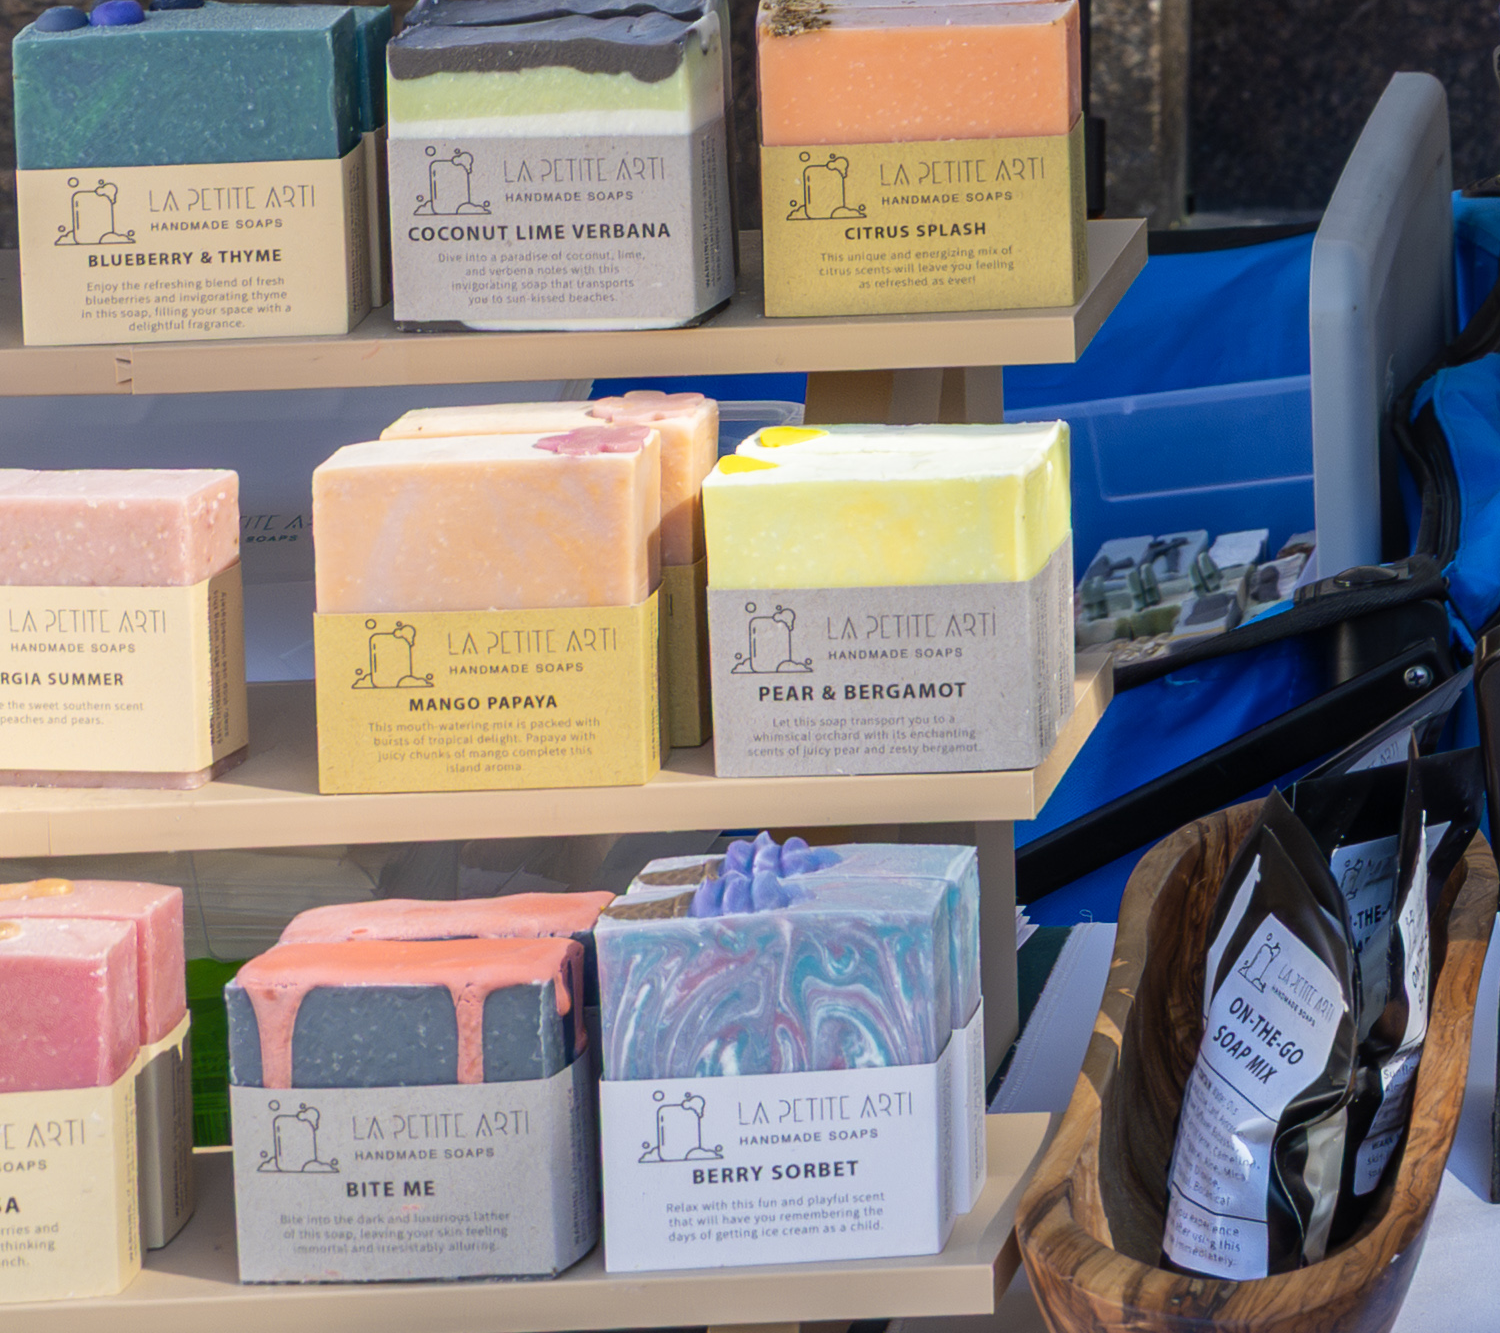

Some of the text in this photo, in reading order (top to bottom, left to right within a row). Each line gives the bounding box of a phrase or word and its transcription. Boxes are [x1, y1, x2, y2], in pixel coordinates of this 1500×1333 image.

[408, 222, 671, 242] COCONUT LIME VERBANA
[844, 222, 986, 241] CITRUS SPLASH
[88, 248, 282, 268] BLUEBERRY & THYME
[245, 534, 298, 543] SOAPS
[828, 647, 963, 660] HANDMADE SOAPS
[0, 671, 124, 686] RGIA SUMMER
[758, 681, 967, 702] PEAR & BERGAMOT
[409, 694, 558, 712] MANGO PAPAYA
[1229, 997, 1304, 1066] ON-THE-GO
[1212, 1025, 1278, 1085] SOAP MIX
[738, 1090, 913, 1125] LA PETITE ARTI
[739, 1128, 879, 1146] HANDMADE SOAPS
[692, 1160, 859, 1185] BERRY SORBET
[346, 1180, 435, 1198] BITE ME
[666, 1192, 885, 1213] Relax with this fun and playful scent
